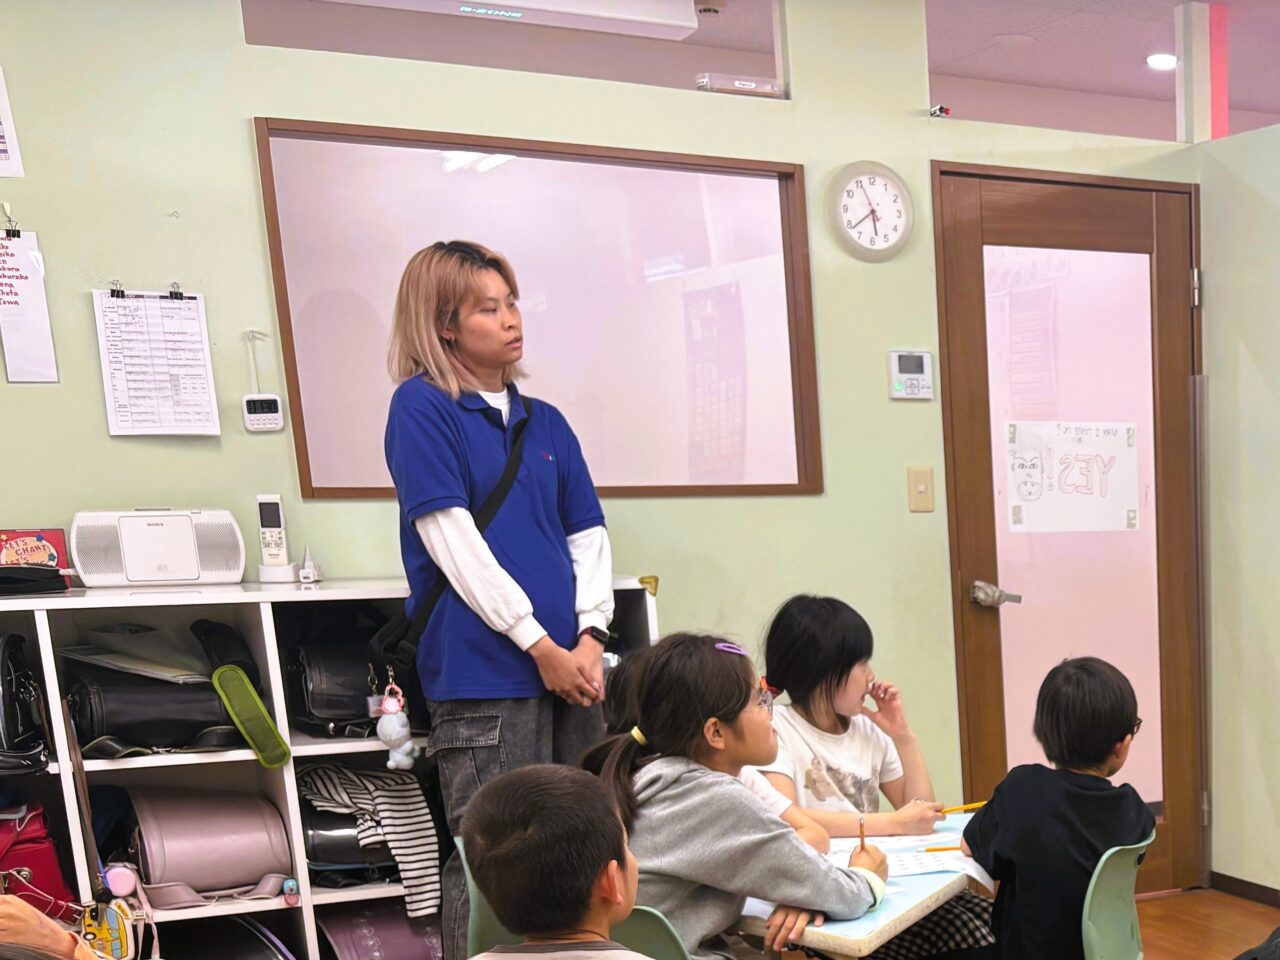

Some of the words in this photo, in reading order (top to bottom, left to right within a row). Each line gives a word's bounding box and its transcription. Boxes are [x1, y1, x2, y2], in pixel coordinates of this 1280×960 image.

[855, 180, 863, 189] 11
[868, 176, 877, 186] 12
[884, 183, 888, 192] 1
[846, 189, 855, 199] 10
[892, 194, 899, 204] 2
[842, 204, 848, 214] 9
[896, 209, 902, 219] 3
[846, 219, 853, 230] 8
[892, 224, 898, 233] 4
[857, 231, 863, 240] 7
[883, 234, 889, 243] 5
[870, 237, 876, 246] 6
[3, 539, 28, 550] LET'S
[15, 544, 47, 556] CHANT
